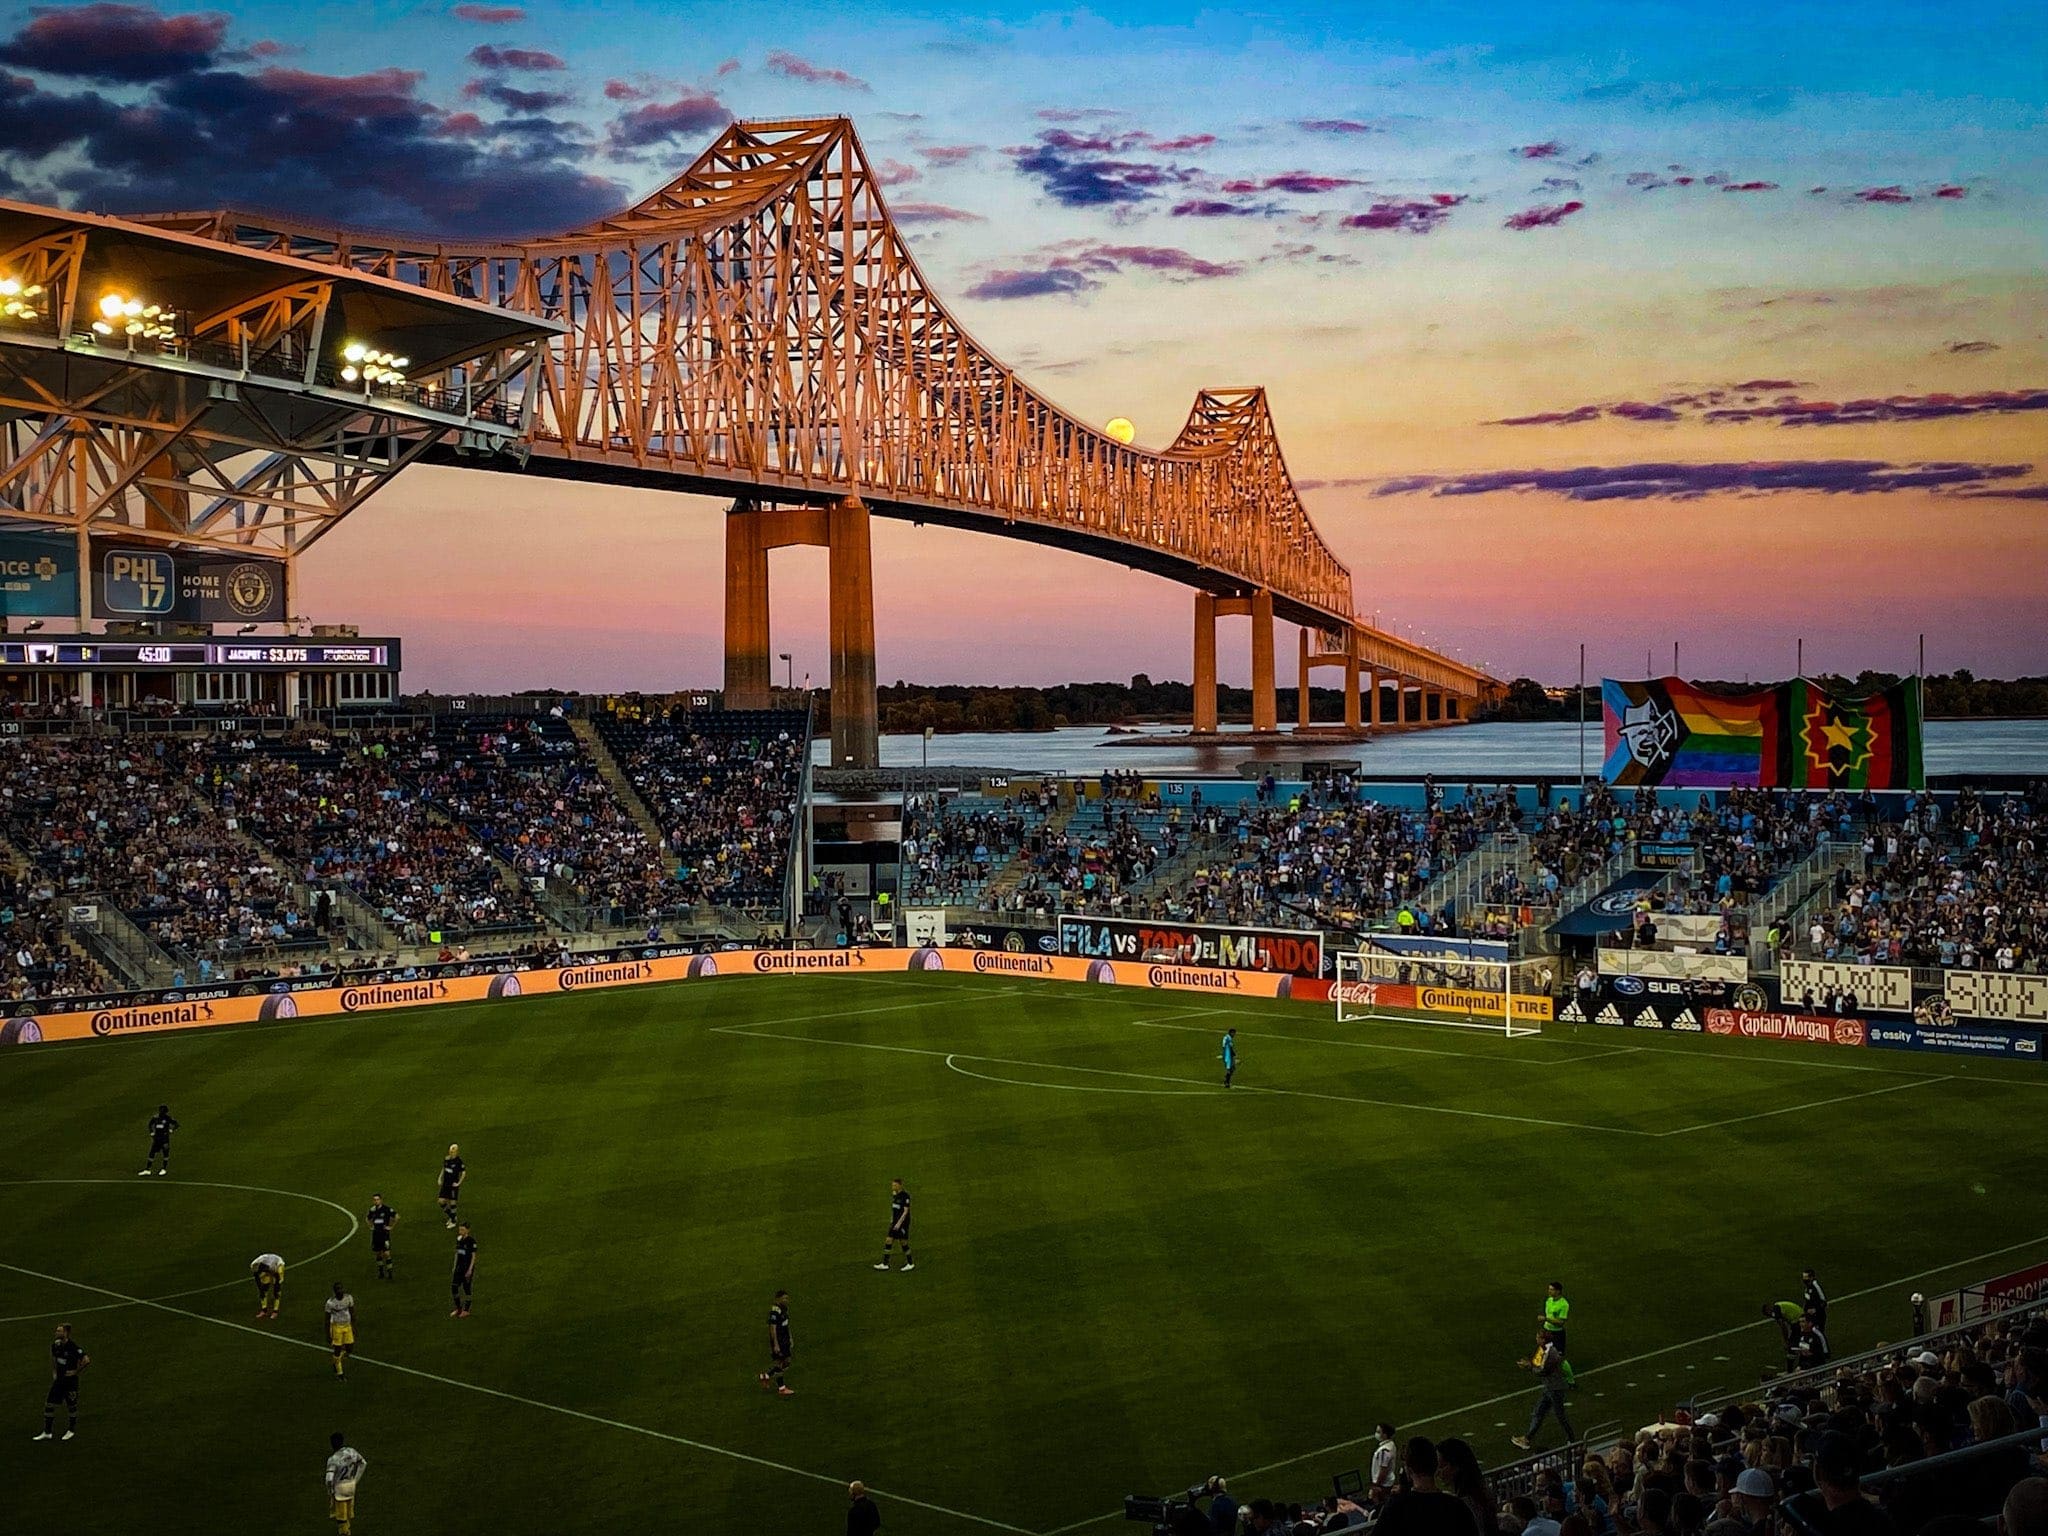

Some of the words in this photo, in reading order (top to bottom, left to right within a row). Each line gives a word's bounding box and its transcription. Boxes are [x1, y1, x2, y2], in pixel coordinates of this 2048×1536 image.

[113, 556, 165, 583] PHL
[183, 575, 220, 587] HOME
[139, 583, 166, 608] 17
[183, 589, 198, 598] OF
[200, 589, 220, 599] THE
[137, 647, 171, 662] 45:00
[269, 649, 307, 662] $3,075
[452, 700, 466, 709] 132
[692, 696, 708, 706] 133
[1, 723, 19, 733] 130
[220, 720, 236, 730] 131
[990, 777, 1008, 787] 134
[1169, 784, 1183, 793] 135
[1430, 787, 1444, 798] 36
[659, 947, 693, 958] SUBARU
[1062, 924, 1113, 957] FILA
[1218, 934, 1318, 973] MUNDO
[754, 951, 850, 972] Continental
[974, 951, 1043, 972] Continental
[558, 963, 640, 991] Continental
[1149, 965, 1228, 988] Continental
[292, 981, 333, 991] SUBARU
[186, 990, 229, 1001] SUBARU
[340, 982, 434, 1012] Continental
[1422, 989, 1500, 1011] Continental
[1516, 1000, 1549, 1015] TIRE
[91, 1003, 197, 1035] Continental
[1595, 1016, 1624, 1026] adidas
[1634, 1019, 1663, 1029] adidas
[1671, 1022, 1701, 1032] adidas
[1739, 1012, 1783, 1037] Captain
[1781, 1014, 1831, 1041] Morgan
